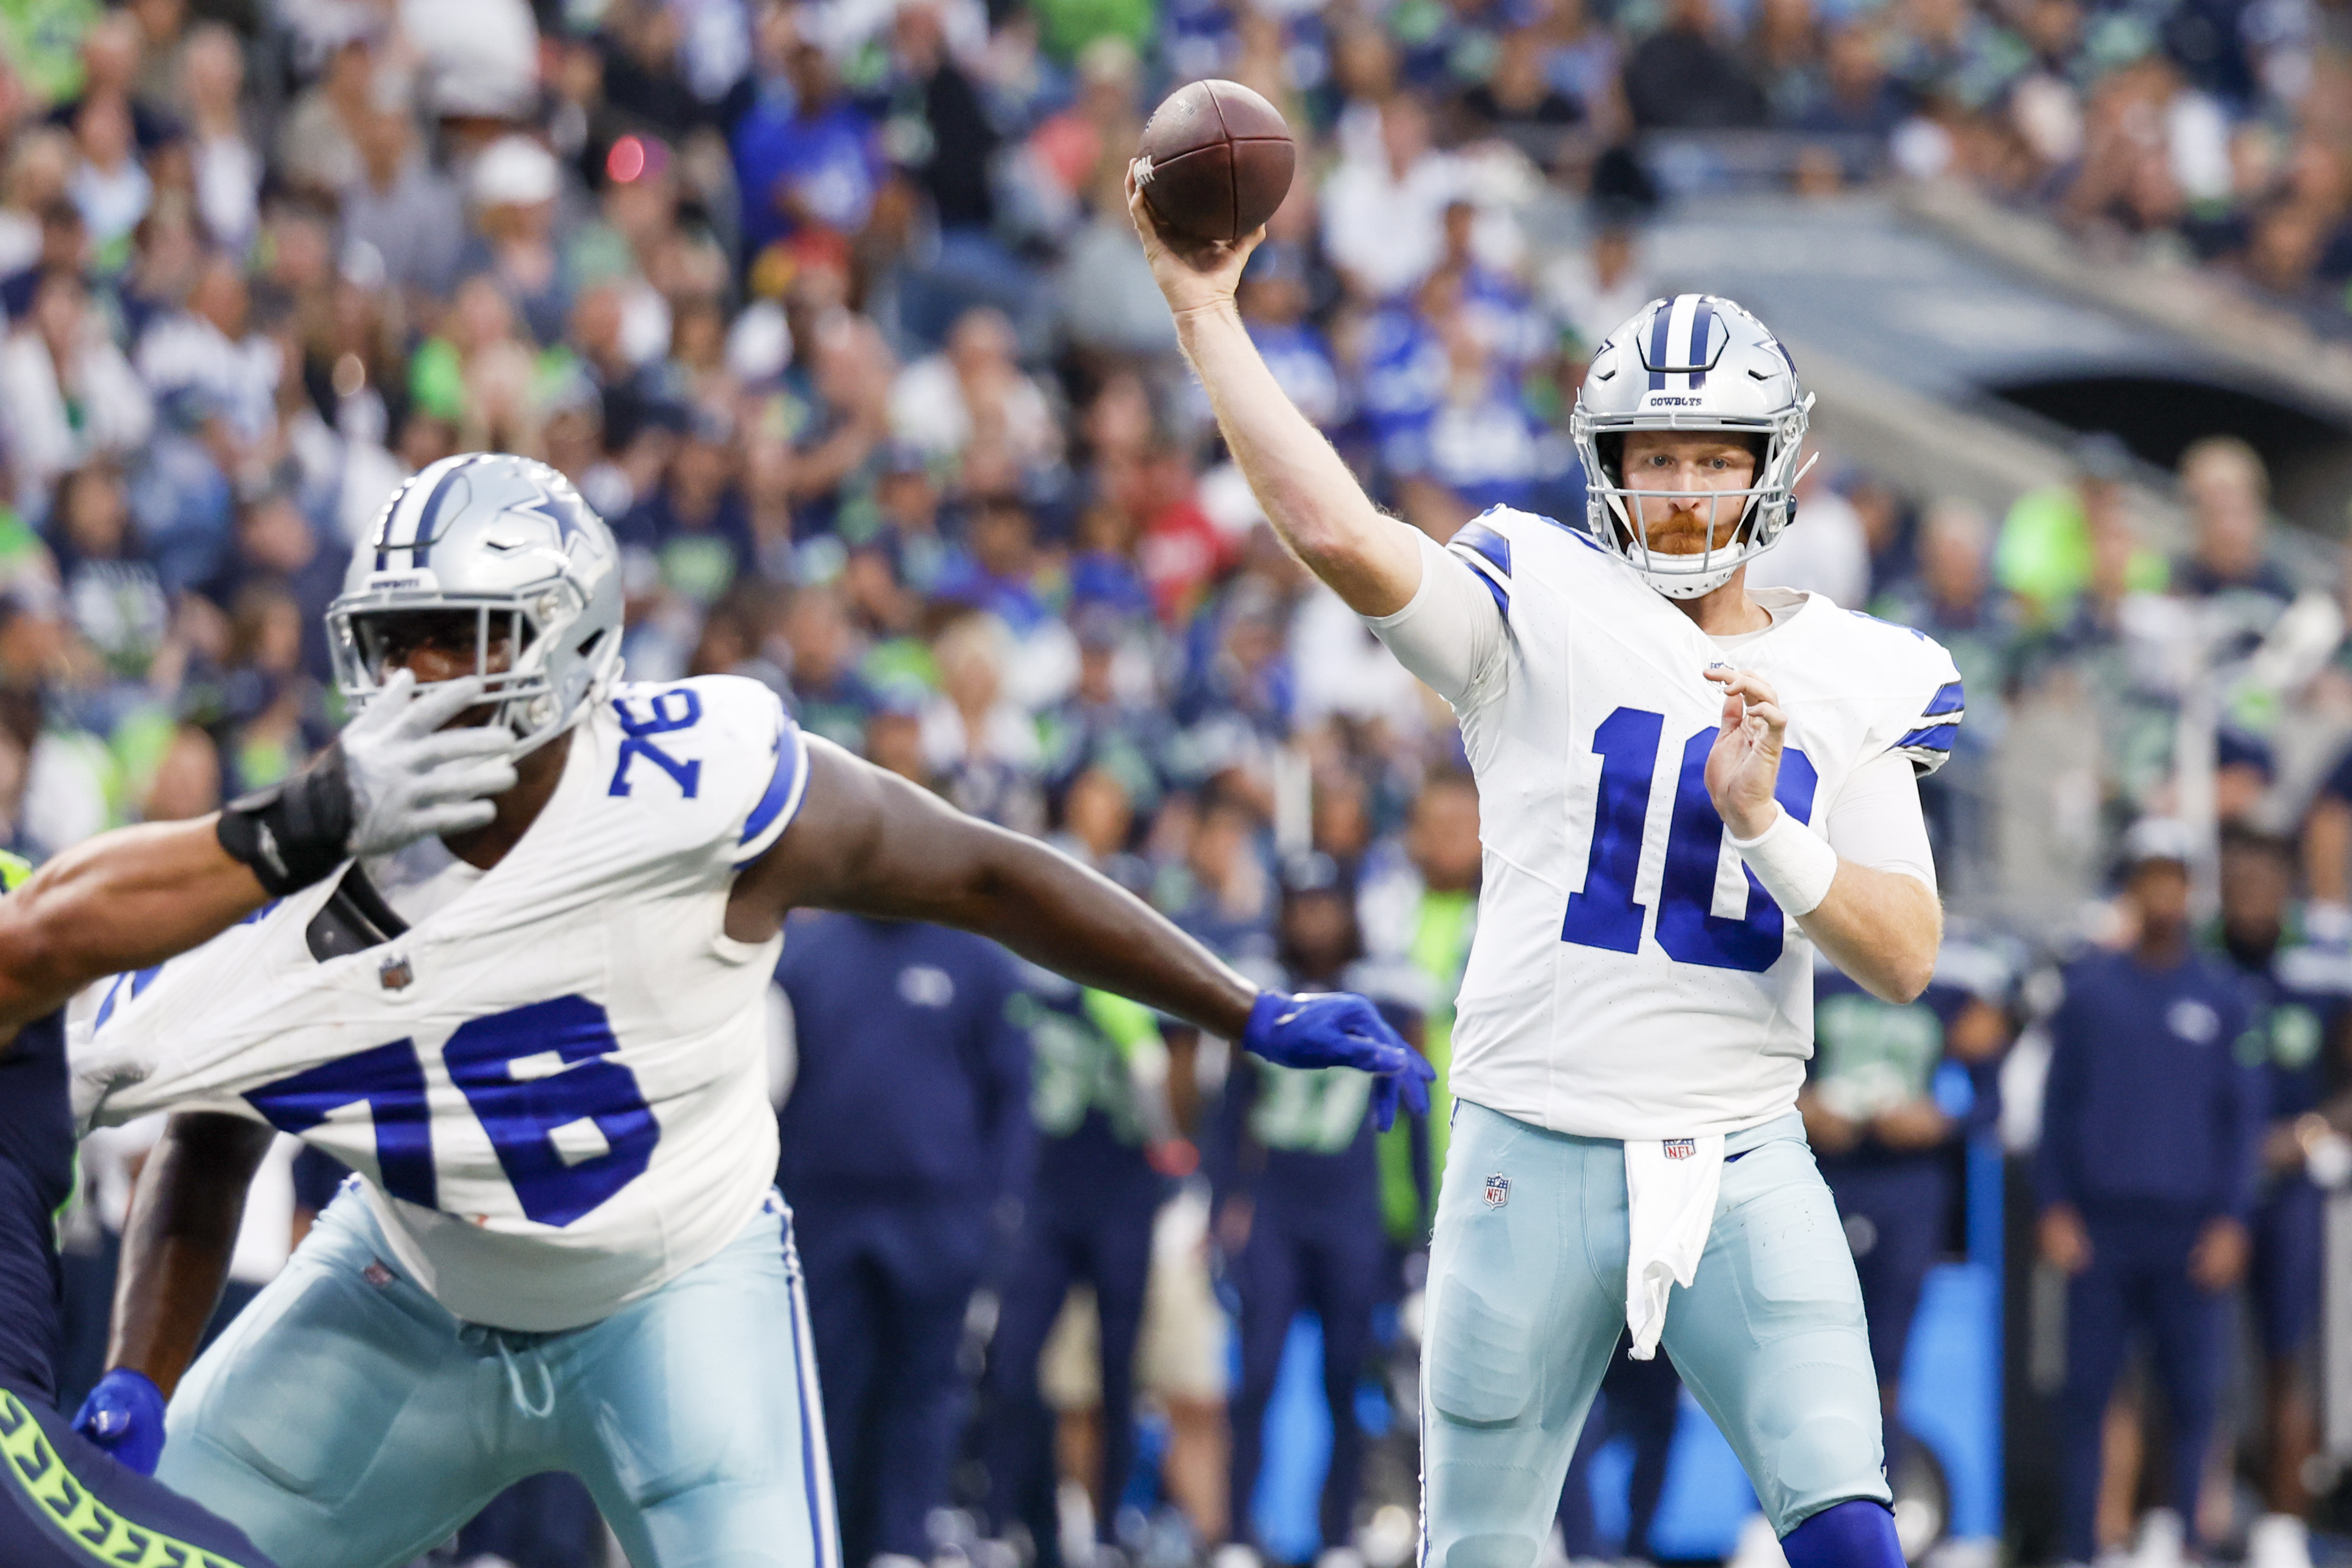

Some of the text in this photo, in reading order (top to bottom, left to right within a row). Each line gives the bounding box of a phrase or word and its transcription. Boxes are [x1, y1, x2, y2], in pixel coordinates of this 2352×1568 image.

[1650, 397, 1702, 406] COWBOYS
[609, 688, 702, 797] 76
[1561, 706, 1818, 973] 10
[244, 993, 661, 1228] 76
[1667, 1146, 1693, 1158] NFL
[1487, 1188, 1504, 1202] NFL
